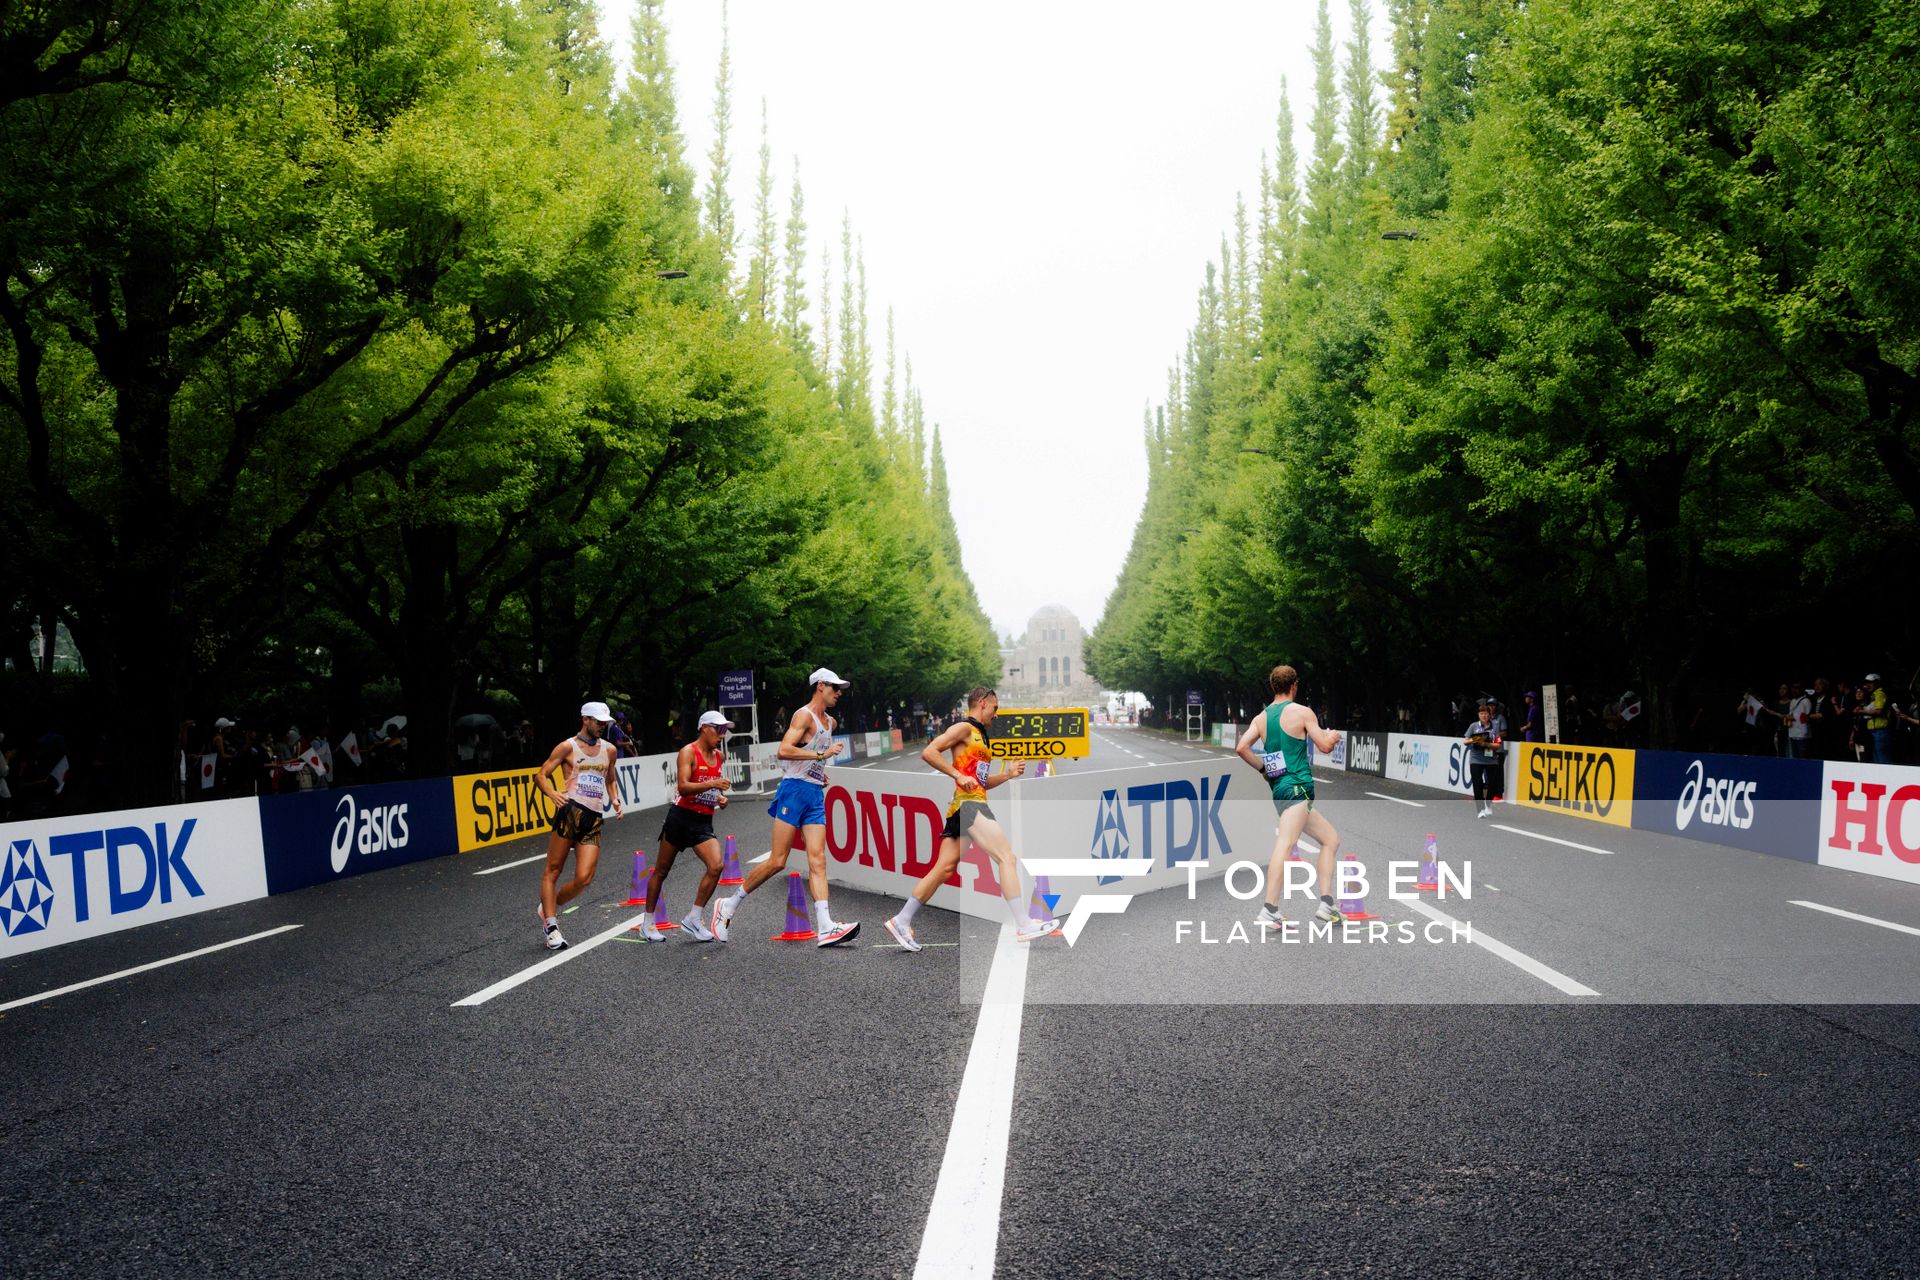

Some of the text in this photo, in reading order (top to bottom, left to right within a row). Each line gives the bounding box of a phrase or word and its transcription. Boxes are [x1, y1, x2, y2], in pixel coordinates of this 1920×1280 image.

[728, 692, 744, 700] Split
[991, 741, 1066, 757] SEIKO
[588, 775, 603, 784] TDK
[1529, 747, 1615, 818] SEIKO
[1700, 777, 1757, 830] asics
[358, 803, 408, 855] asics
[1127, 774, 1232, 874] TDK
[49, 818, 205, 923] TDK
